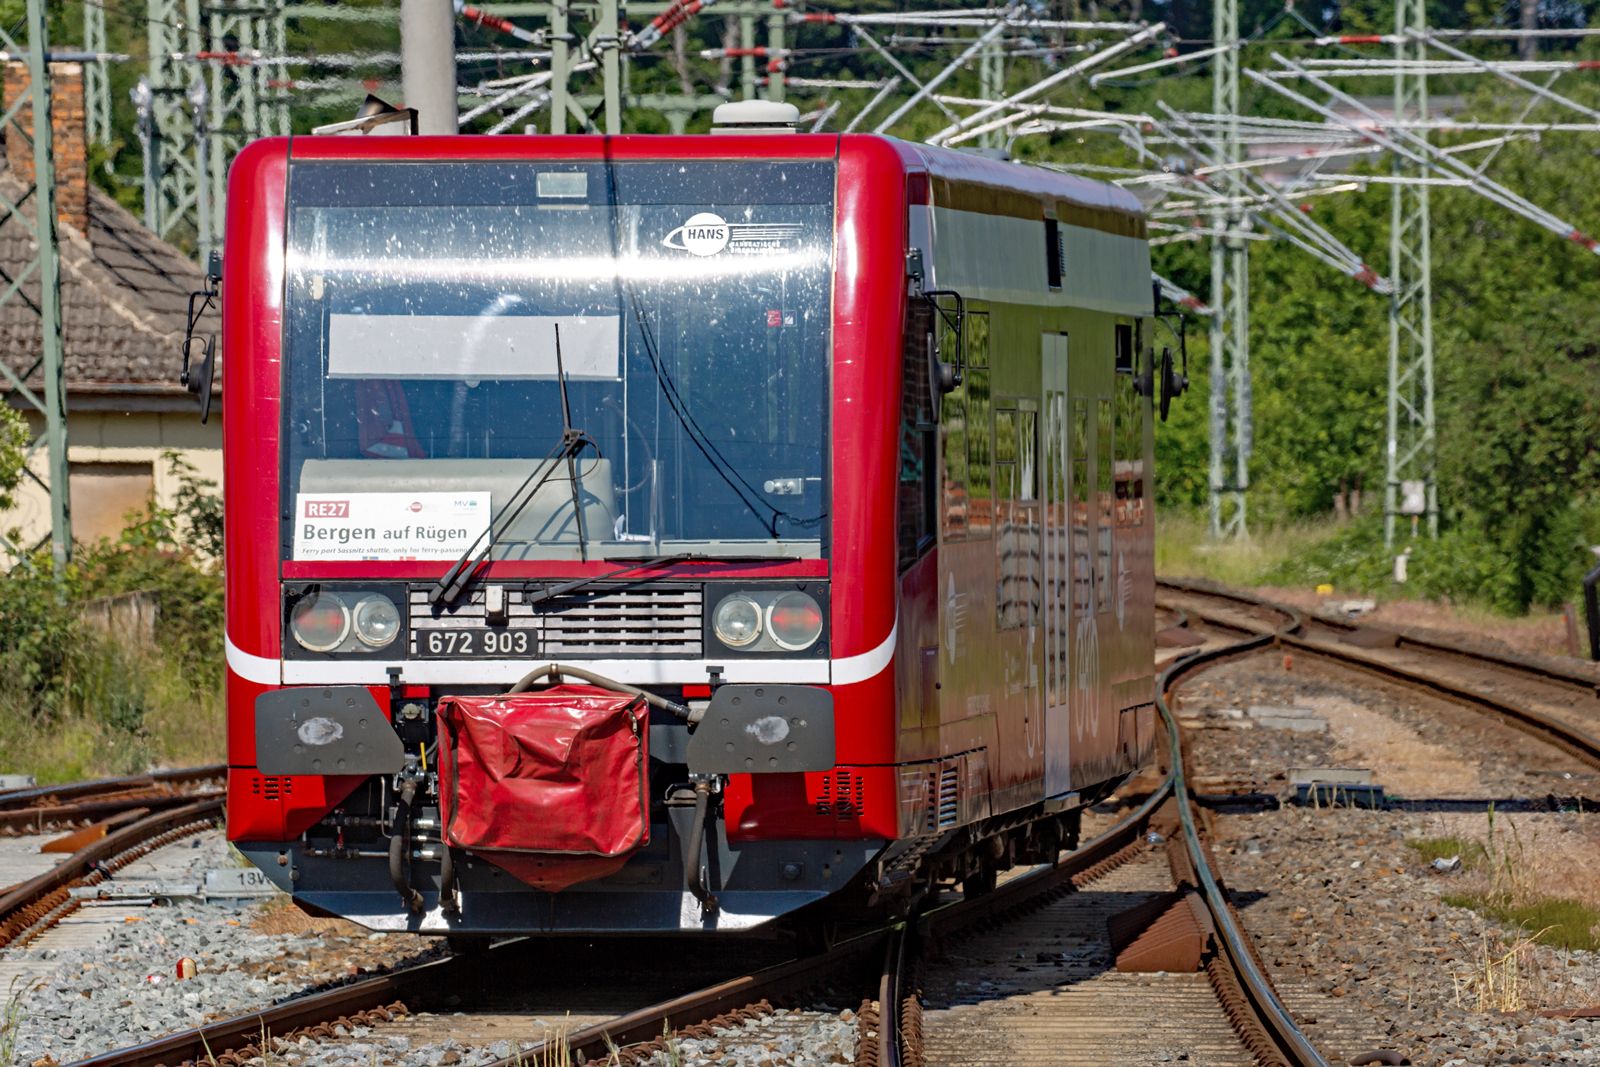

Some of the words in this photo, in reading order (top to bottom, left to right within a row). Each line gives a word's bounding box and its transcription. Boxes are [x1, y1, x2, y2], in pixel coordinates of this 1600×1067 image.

[688, 229, 724, 240] HANS
[308, 503, 347, 516] RE27
[303, 524, 376, 544] Bergen
[383, 526, 411, 540] auf
[415, 526, 468, 542] Rügen
[393, 546, 408, 554] only
[429, 632, 473, 653] 672
[483, 632, 528, 653] 903
